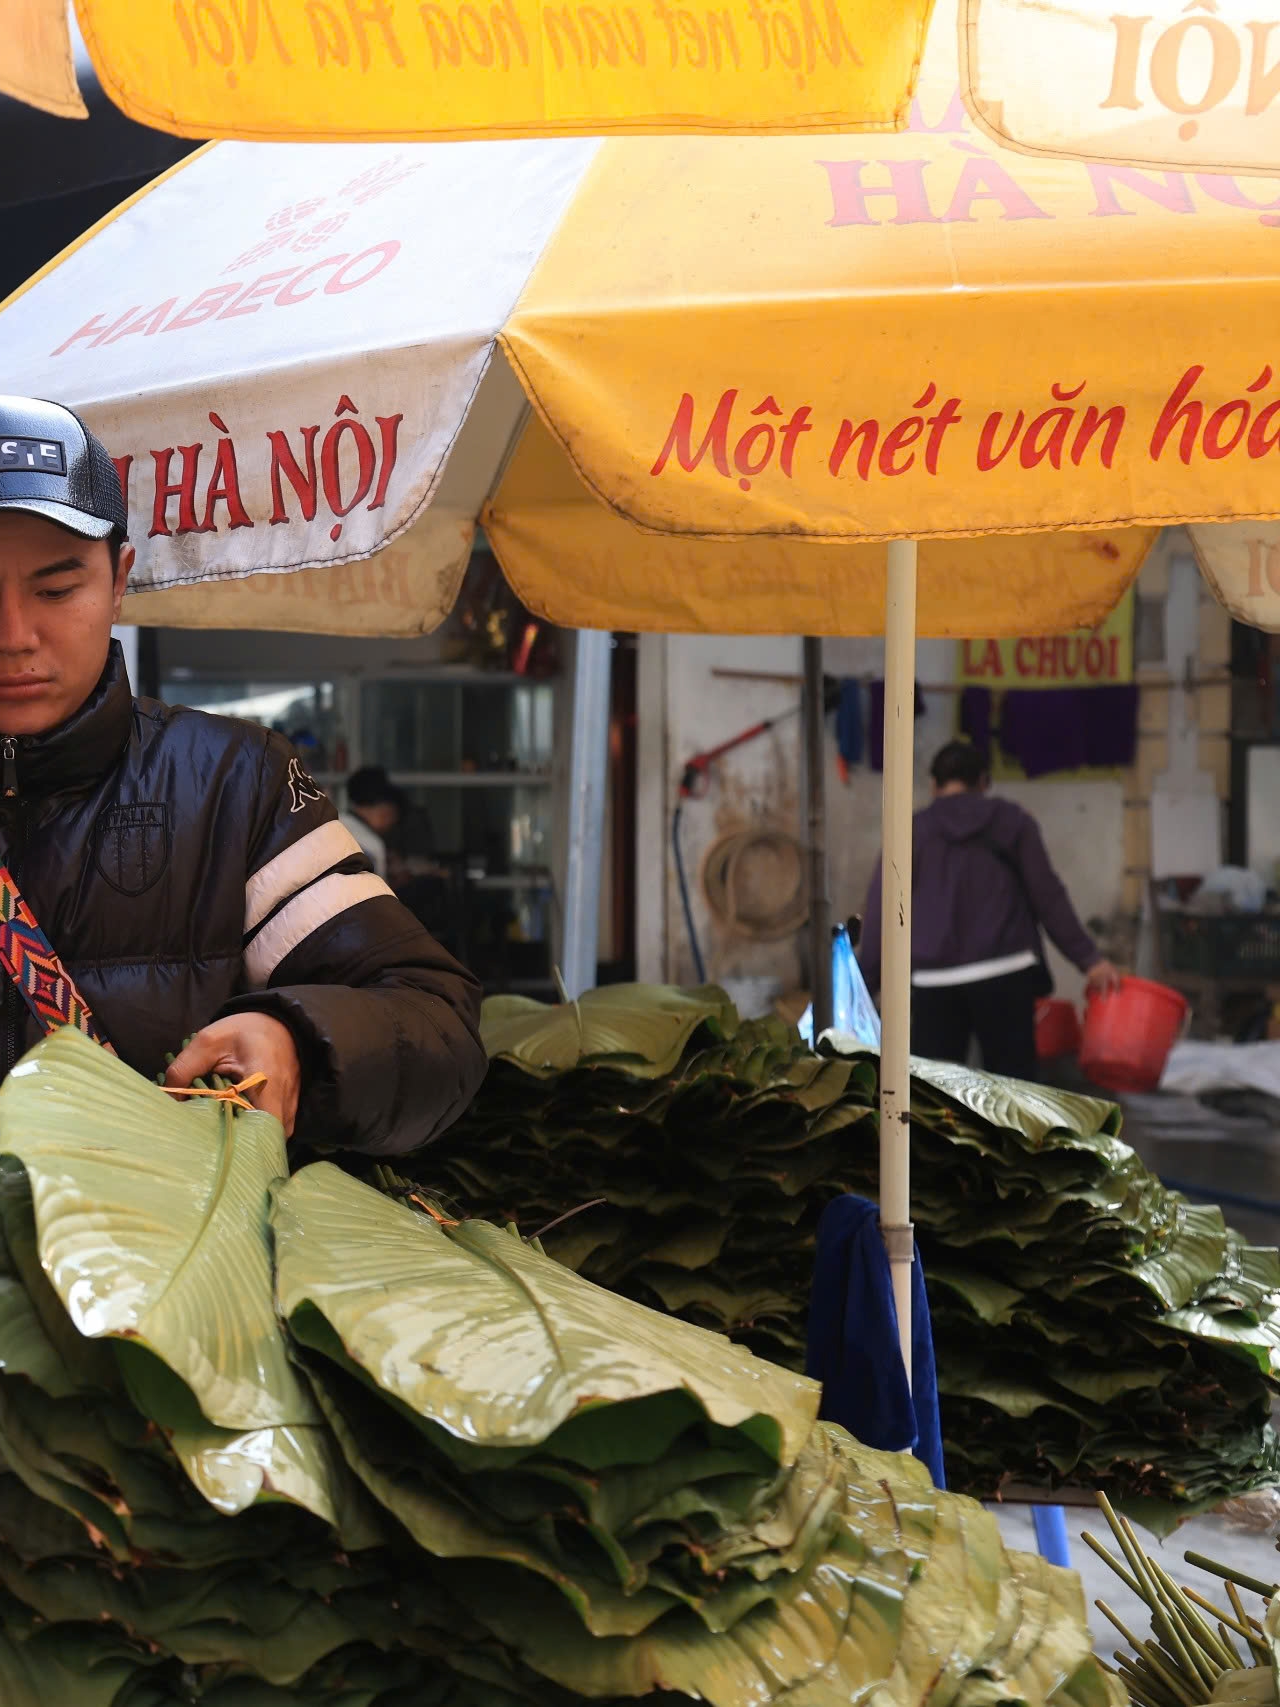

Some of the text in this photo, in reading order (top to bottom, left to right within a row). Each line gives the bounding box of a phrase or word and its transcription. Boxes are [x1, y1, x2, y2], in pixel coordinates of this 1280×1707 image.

[814, 140, 1057, 227] HÀ
[50, 240, 401, 357] HABECO
[148, 411, 254, 538] HÀ
[267, 395, 403, 542] NỘI
[650, 388, 814, 491] Một
[828, 381, 963, 481] nét
[976, 380, 1126, 472] văn
